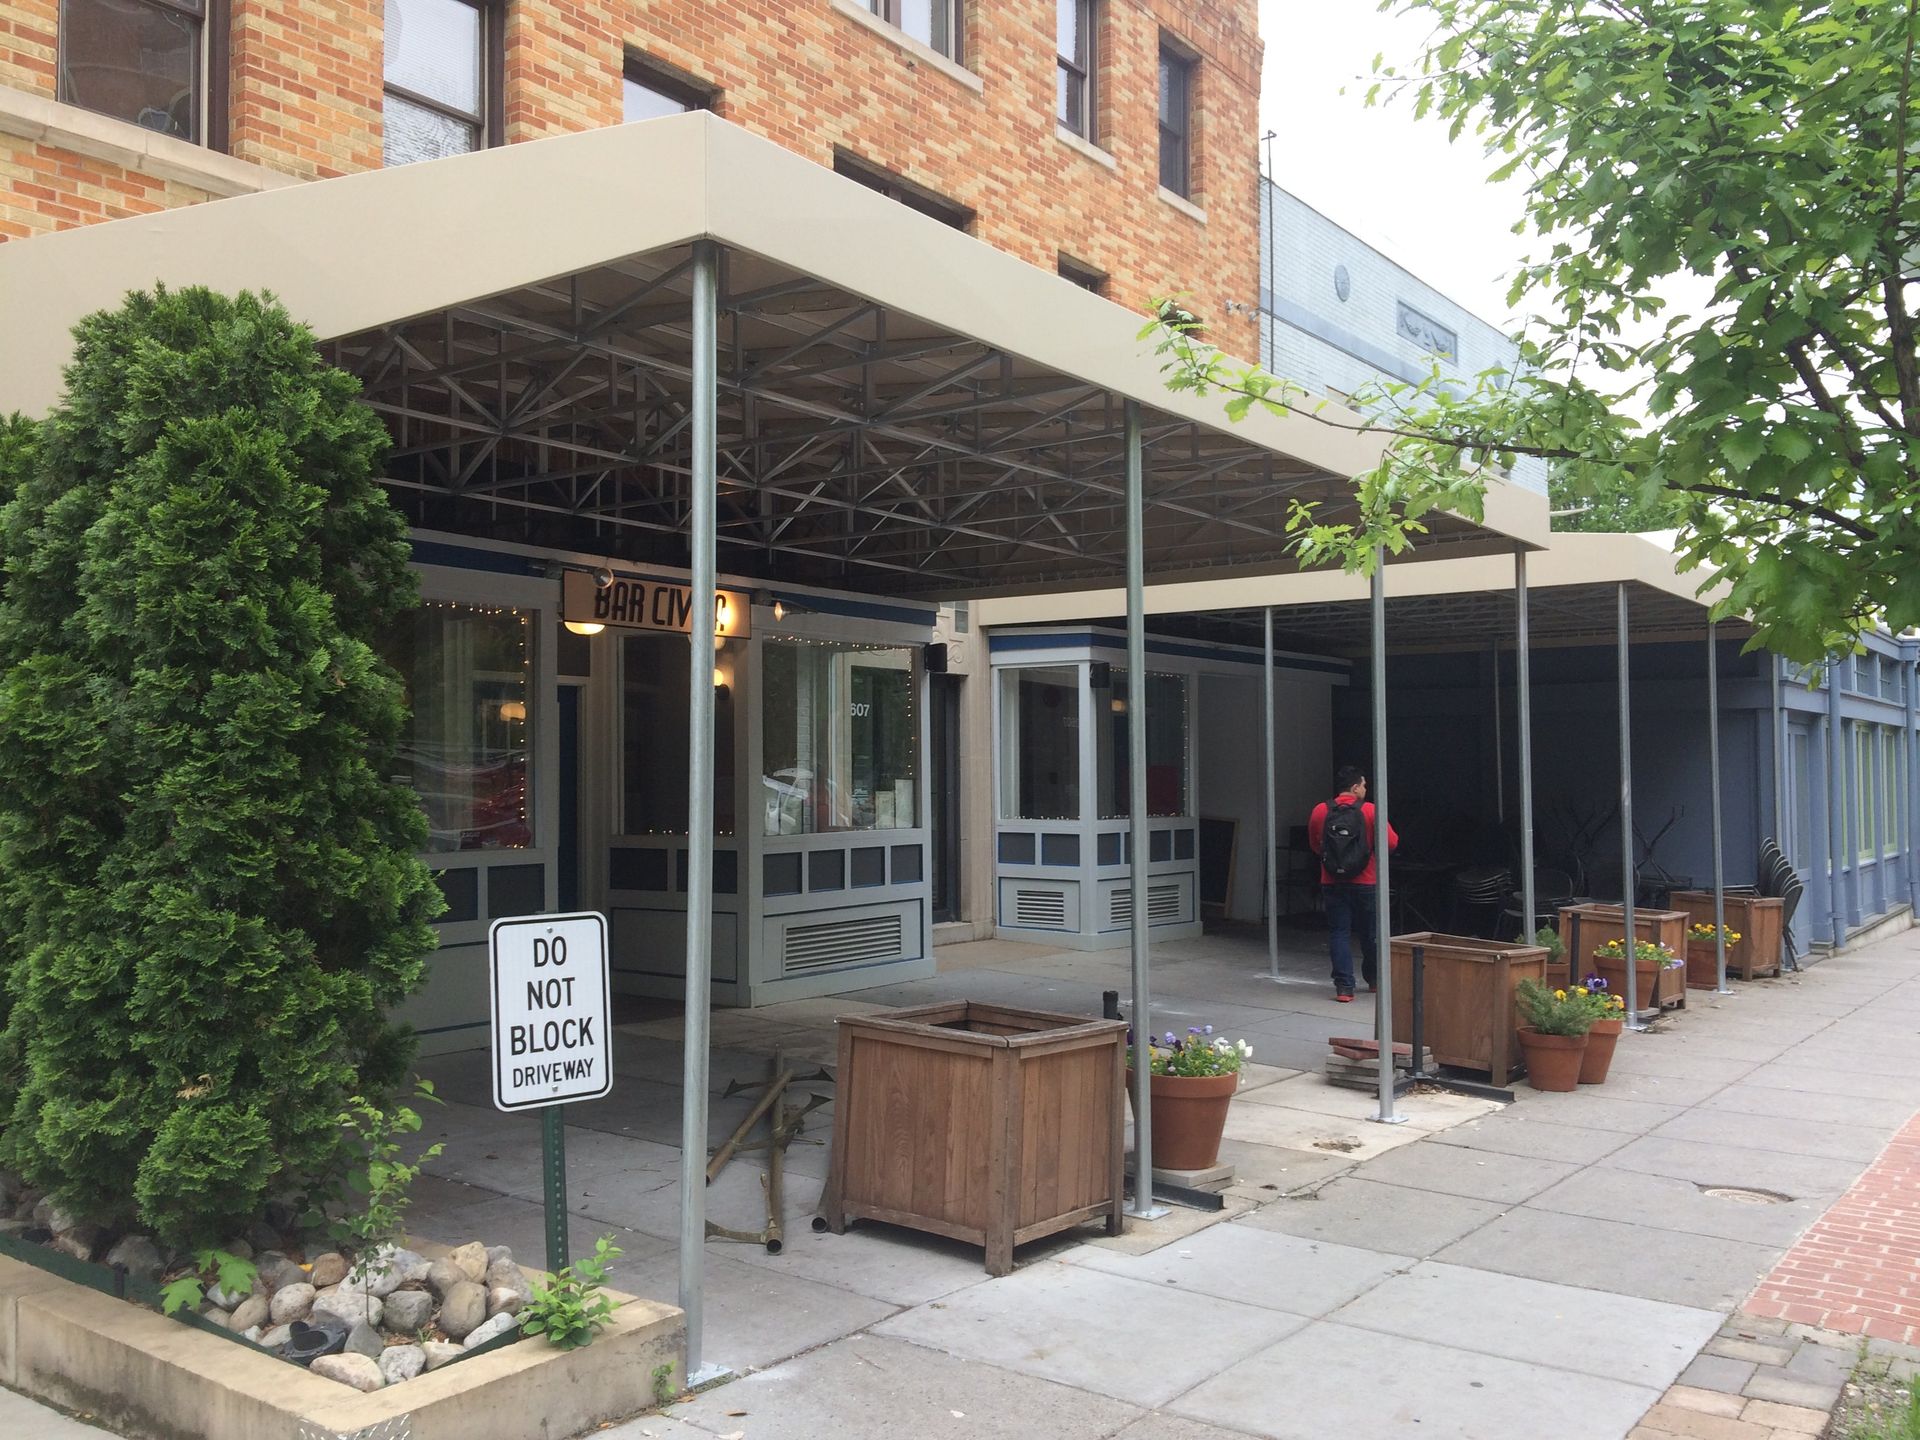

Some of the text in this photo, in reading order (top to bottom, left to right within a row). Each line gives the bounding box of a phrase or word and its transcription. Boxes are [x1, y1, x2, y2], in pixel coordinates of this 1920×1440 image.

[594, 582, 645, 622] BAR
[533, 936, 567, 967] DO
[527, 977, 575, 1010] NOT
[510, 1017, 594, 1055] BLOCK
[513, 1058, 594, 1088] DRIVEWAY
